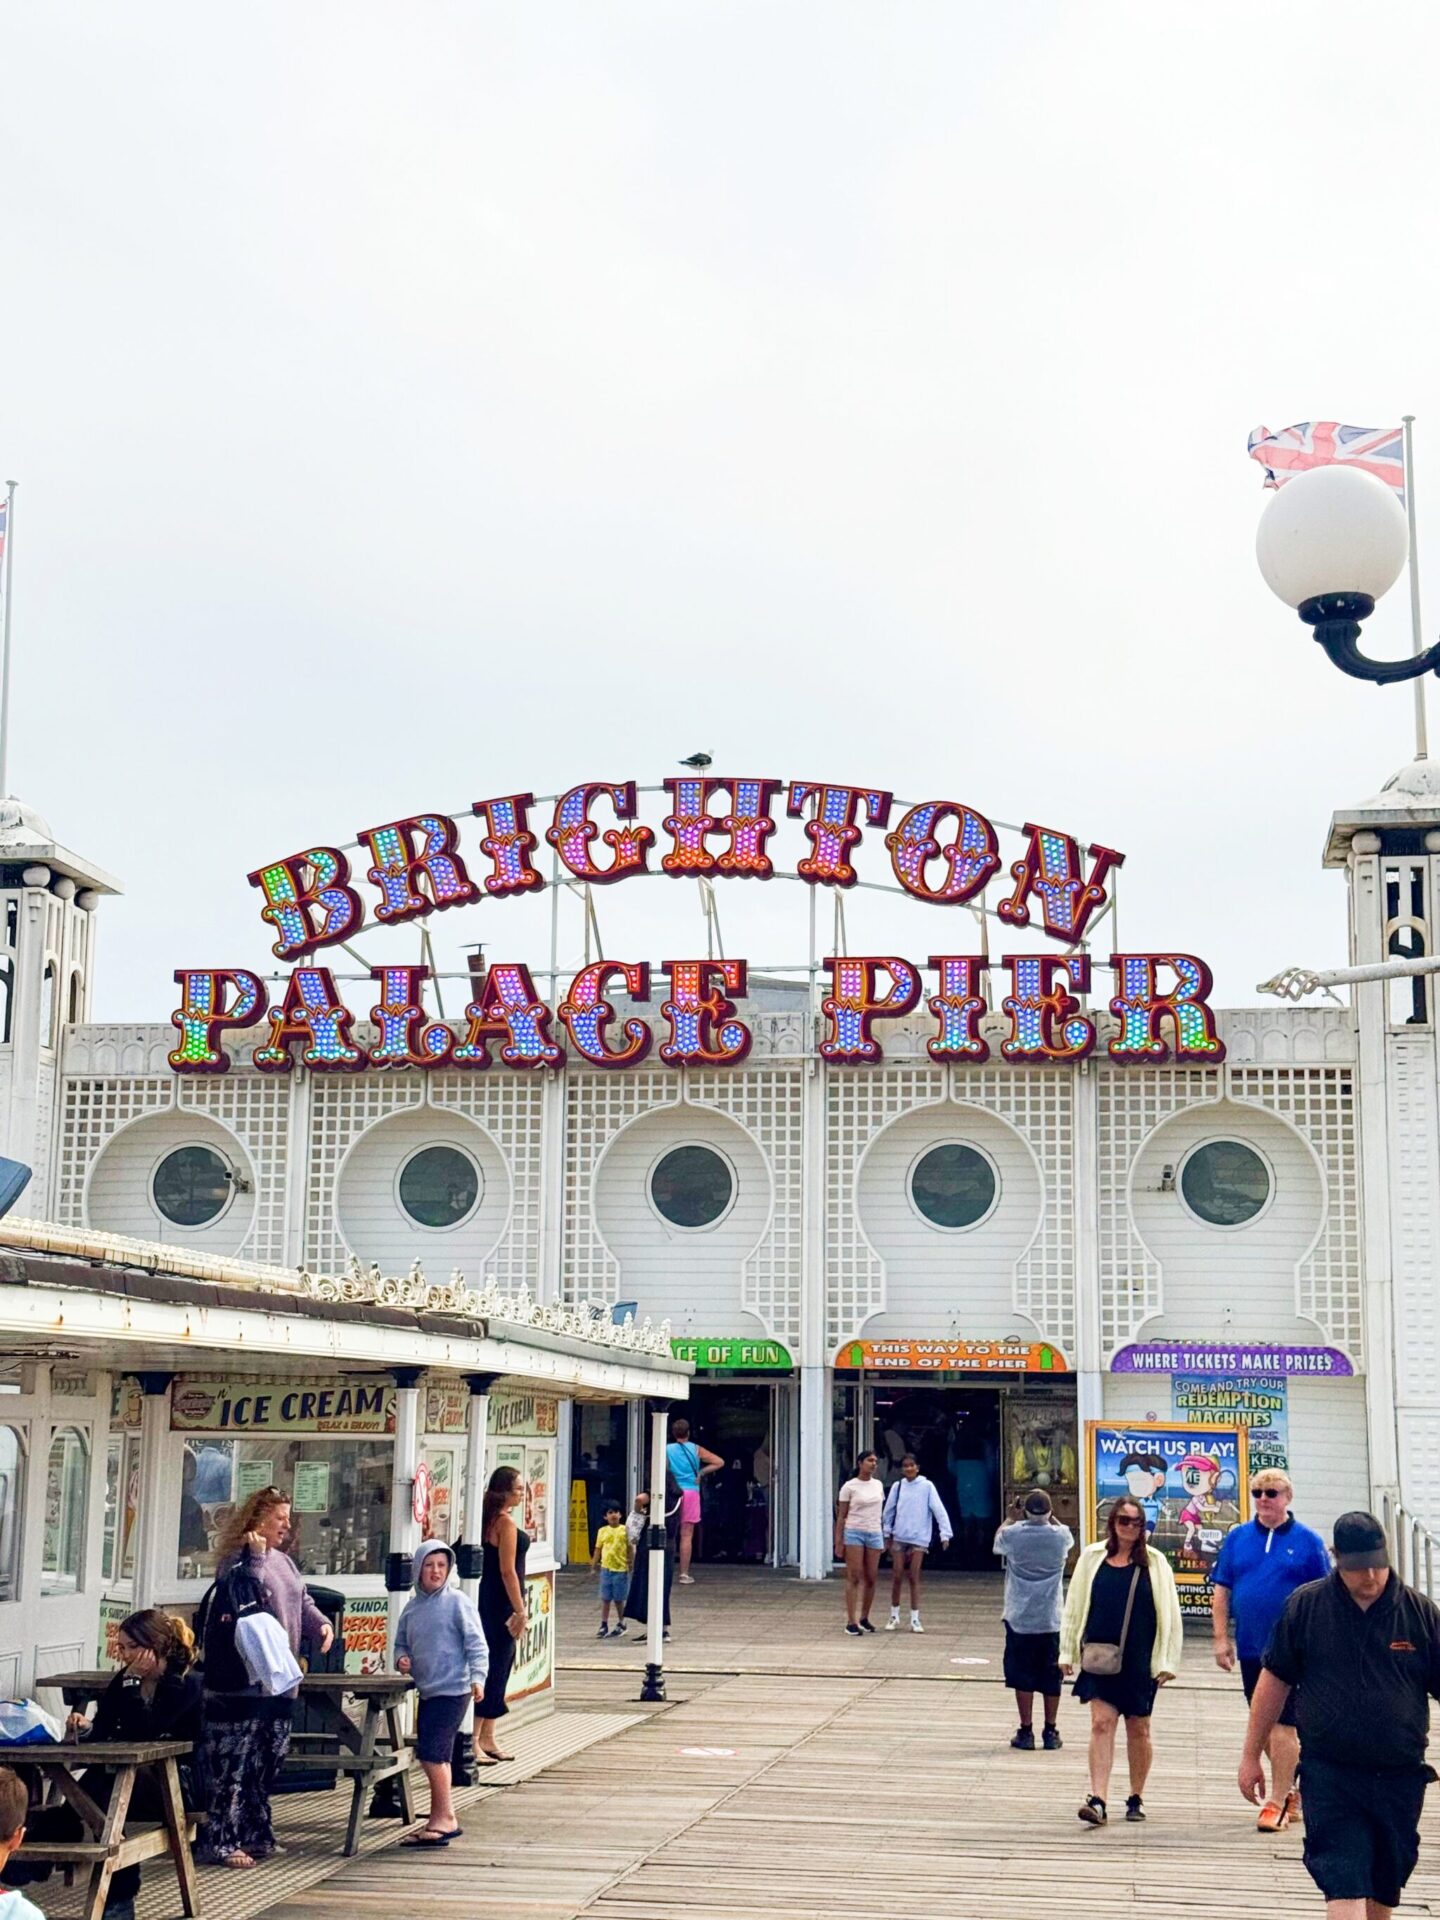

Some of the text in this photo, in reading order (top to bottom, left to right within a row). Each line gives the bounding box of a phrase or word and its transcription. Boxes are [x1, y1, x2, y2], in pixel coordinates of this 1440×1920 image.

[247, 778, 1126, 962] BRIGHTON
[168, 953, 1227, 1074] PALACE PIER
[707, 1346, 732, 1363] OF
[741, 1346, 779, 1363] FUN
[871, 1344, 1030, 1355] THIS WAY TO THE
[874, 1358, 1027, 1369] END OF THE PIER
[1132, 1352, 1333, 1371] WHERE TICKETS MAKE PRIZES
[1174, 1377, 1285, 1394] COME AND TRY OUR
[219, 1395, 272, 1426] ICE
[280, 1387, 384, 1421] CREAM
[1176, 1390, 1282, 1411] REDEMPTION
[495, 1404, 509, 1431] ICE
[510, 1396, 535, 1427] CREAM
[1188, 1410, 1272, 1427] MACHINES
[1100, 1439, 1235, 1457] WATCH US PLAY!
